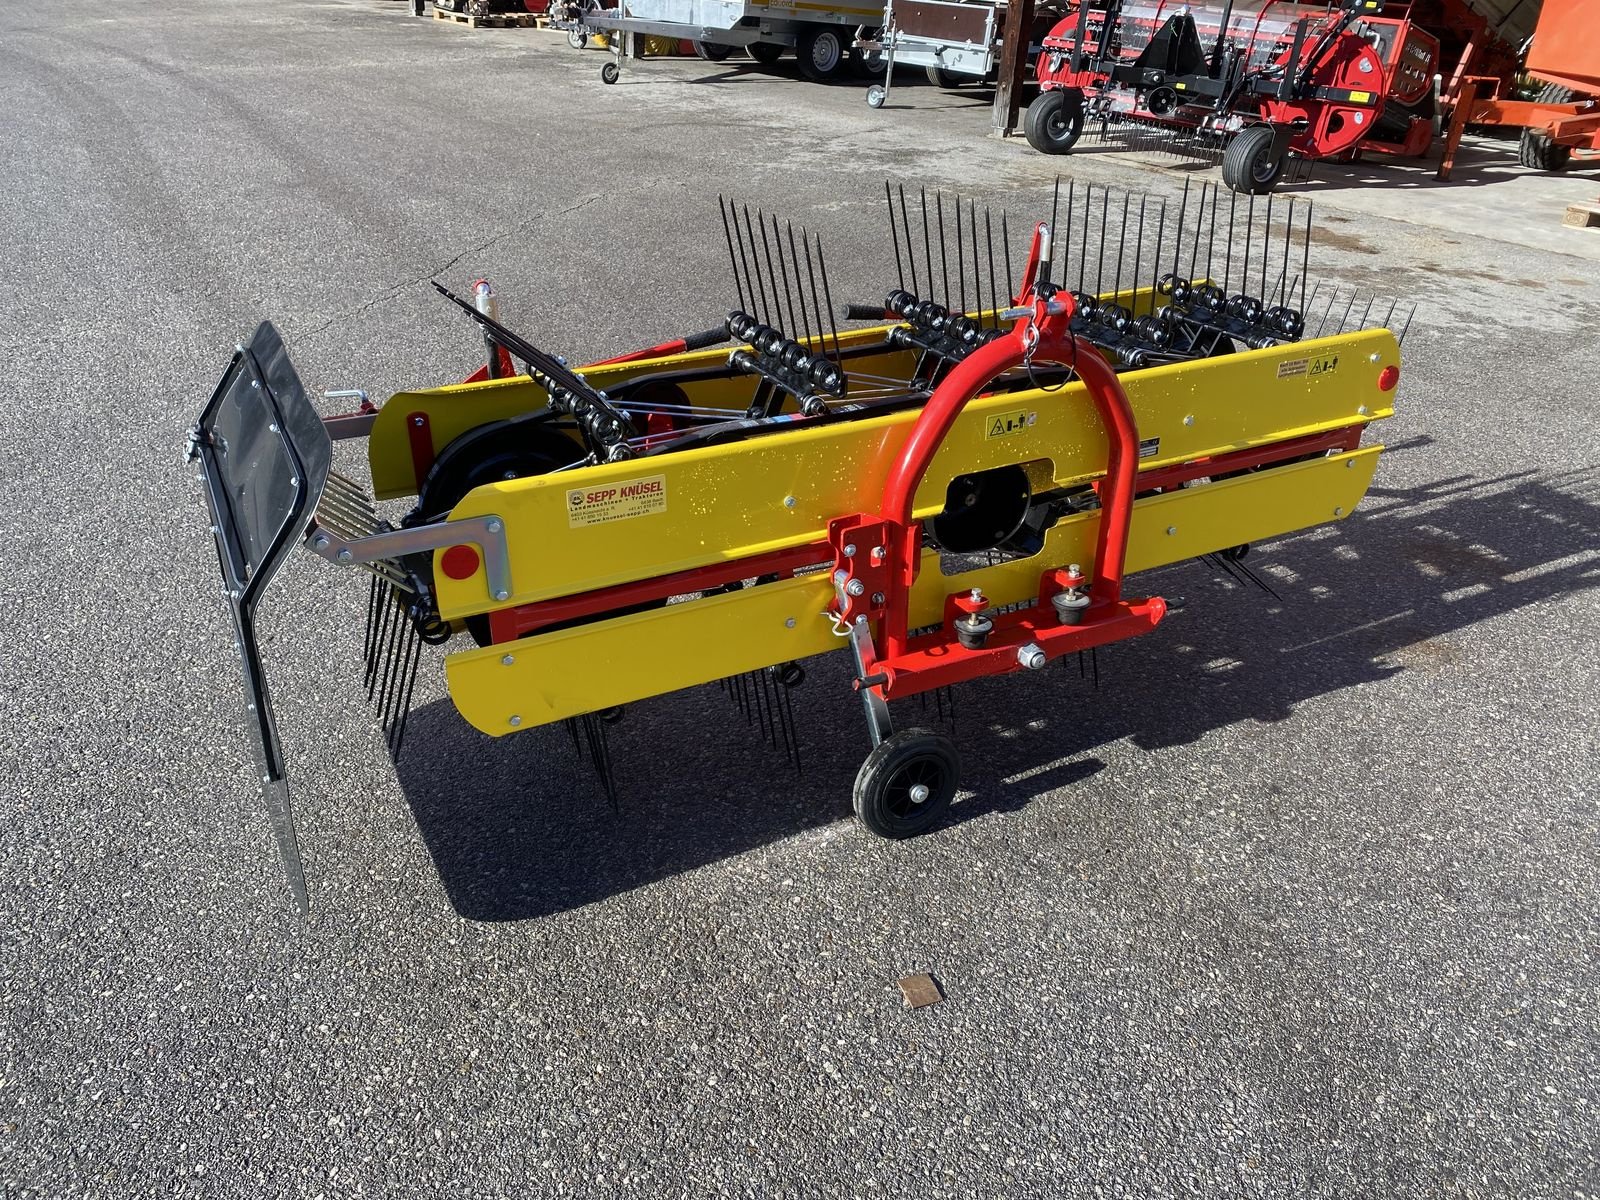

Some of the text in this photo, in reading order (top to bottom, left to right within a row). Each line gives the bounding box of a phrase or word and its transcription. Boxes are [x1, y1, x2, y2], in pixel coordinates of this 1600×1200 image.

[586, 482, 662, 503] SEPP KNÜSEL
[570, 499, 622, 511] Landmaschinen
